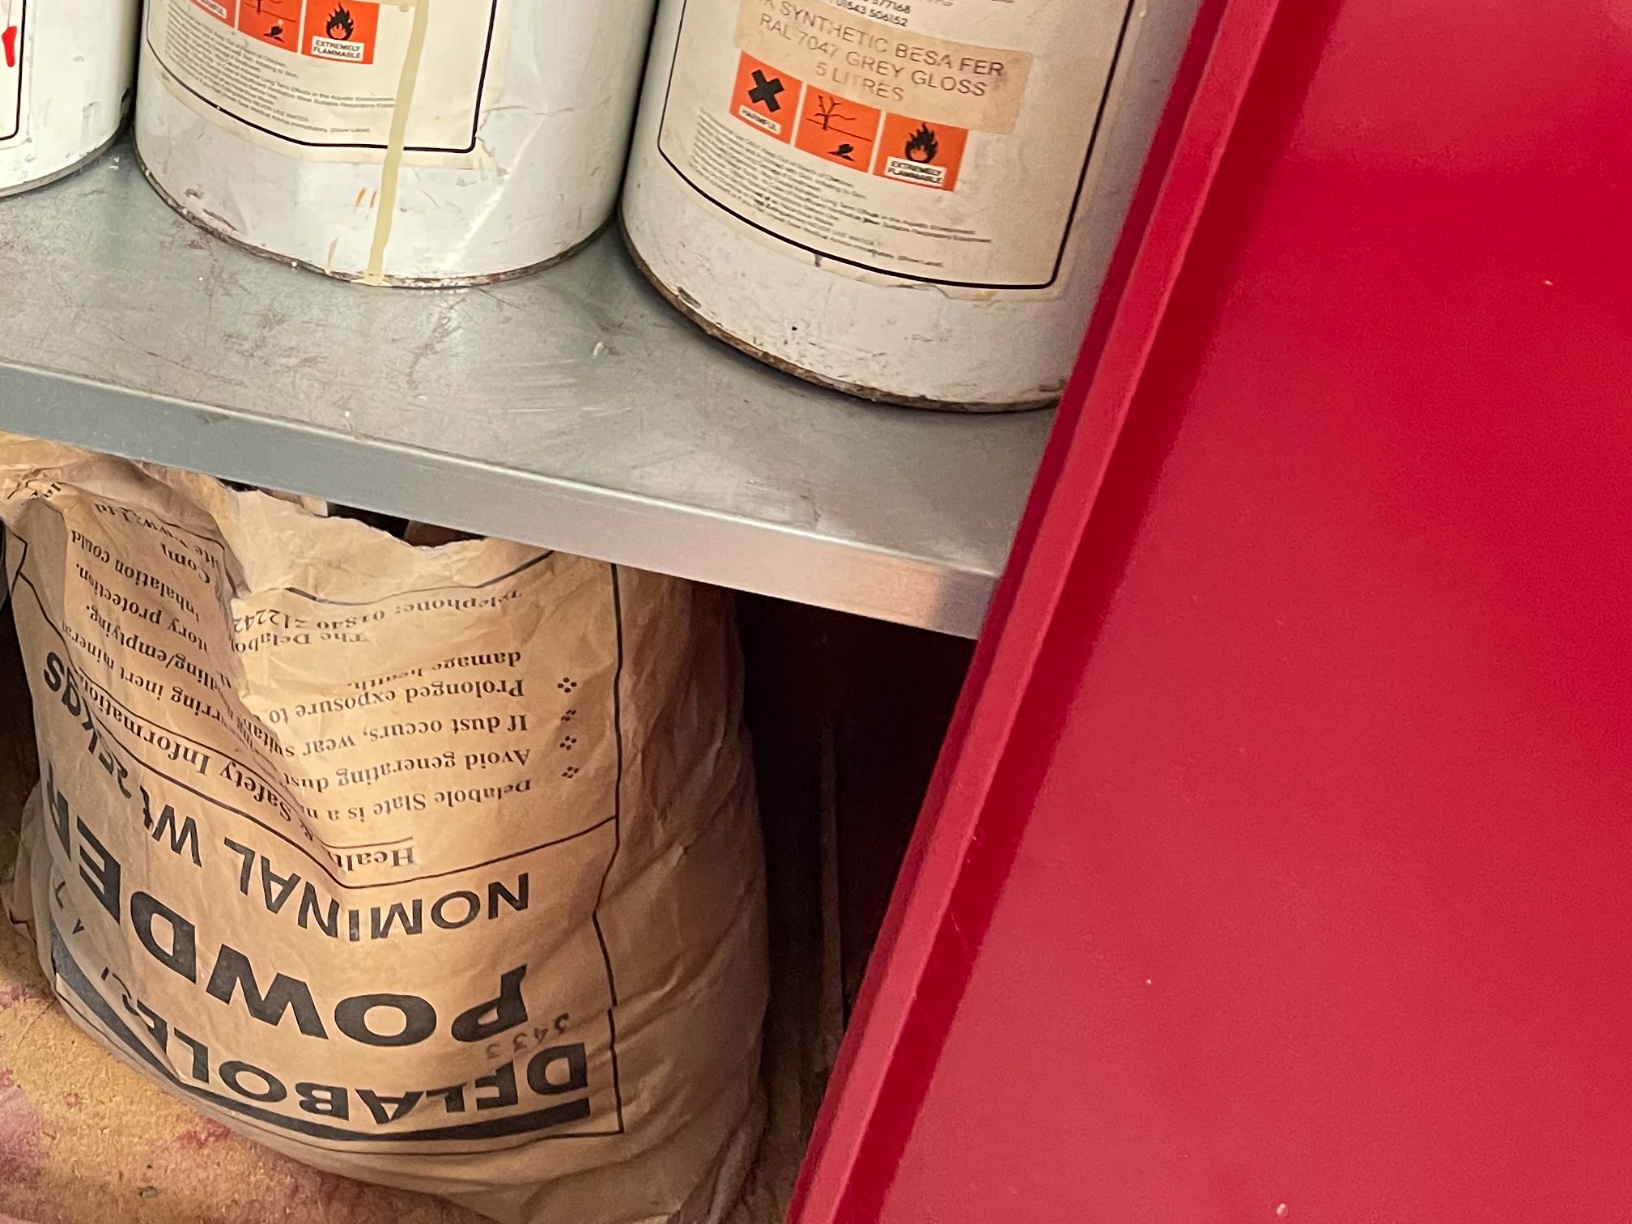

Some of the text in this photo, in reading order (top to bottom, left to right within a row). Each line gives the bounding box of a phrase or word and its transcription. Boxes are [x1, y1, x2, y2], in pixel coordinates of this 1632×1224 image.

[868, 8, 909, 27] 506152
[313, 39, 361, 59] EXTREMELY FLAMMABLE
[781, 1, 888, 53] SYNTHETIC
[895, 42, 953, 69] BESA
[959, 58, 1006, 77] FER
[760, 14, 988, 97] RAL 7047 GREY GLOSS
[816, 61, 905, 103] 5 LITRES
[890, 160, 943, 176] EXTREMELY
[70, 529, 110, 565] could
[75, 563, 527, 757] If dust occurs, wear protection.
[431, 651, 521, 672] damage
[120, 666, 163, 702] inert
[405, 678, 524, 703] Prolonged
[268, 707, 288, 725] to
[295, 690, 396, 719] exposure
[335, 748, 530, 789] Avoid generating
[218, 762, 291, 823] Safety
[373, 792, 426, 816] Slate
[434, 779, 531, 804] Delabole
[327, 809, 339, 821] a
[347, 807, 365, 822] is
[37, 758, 527, 1049] POWDER
[222, 836, 530, 943] NOMINAL
